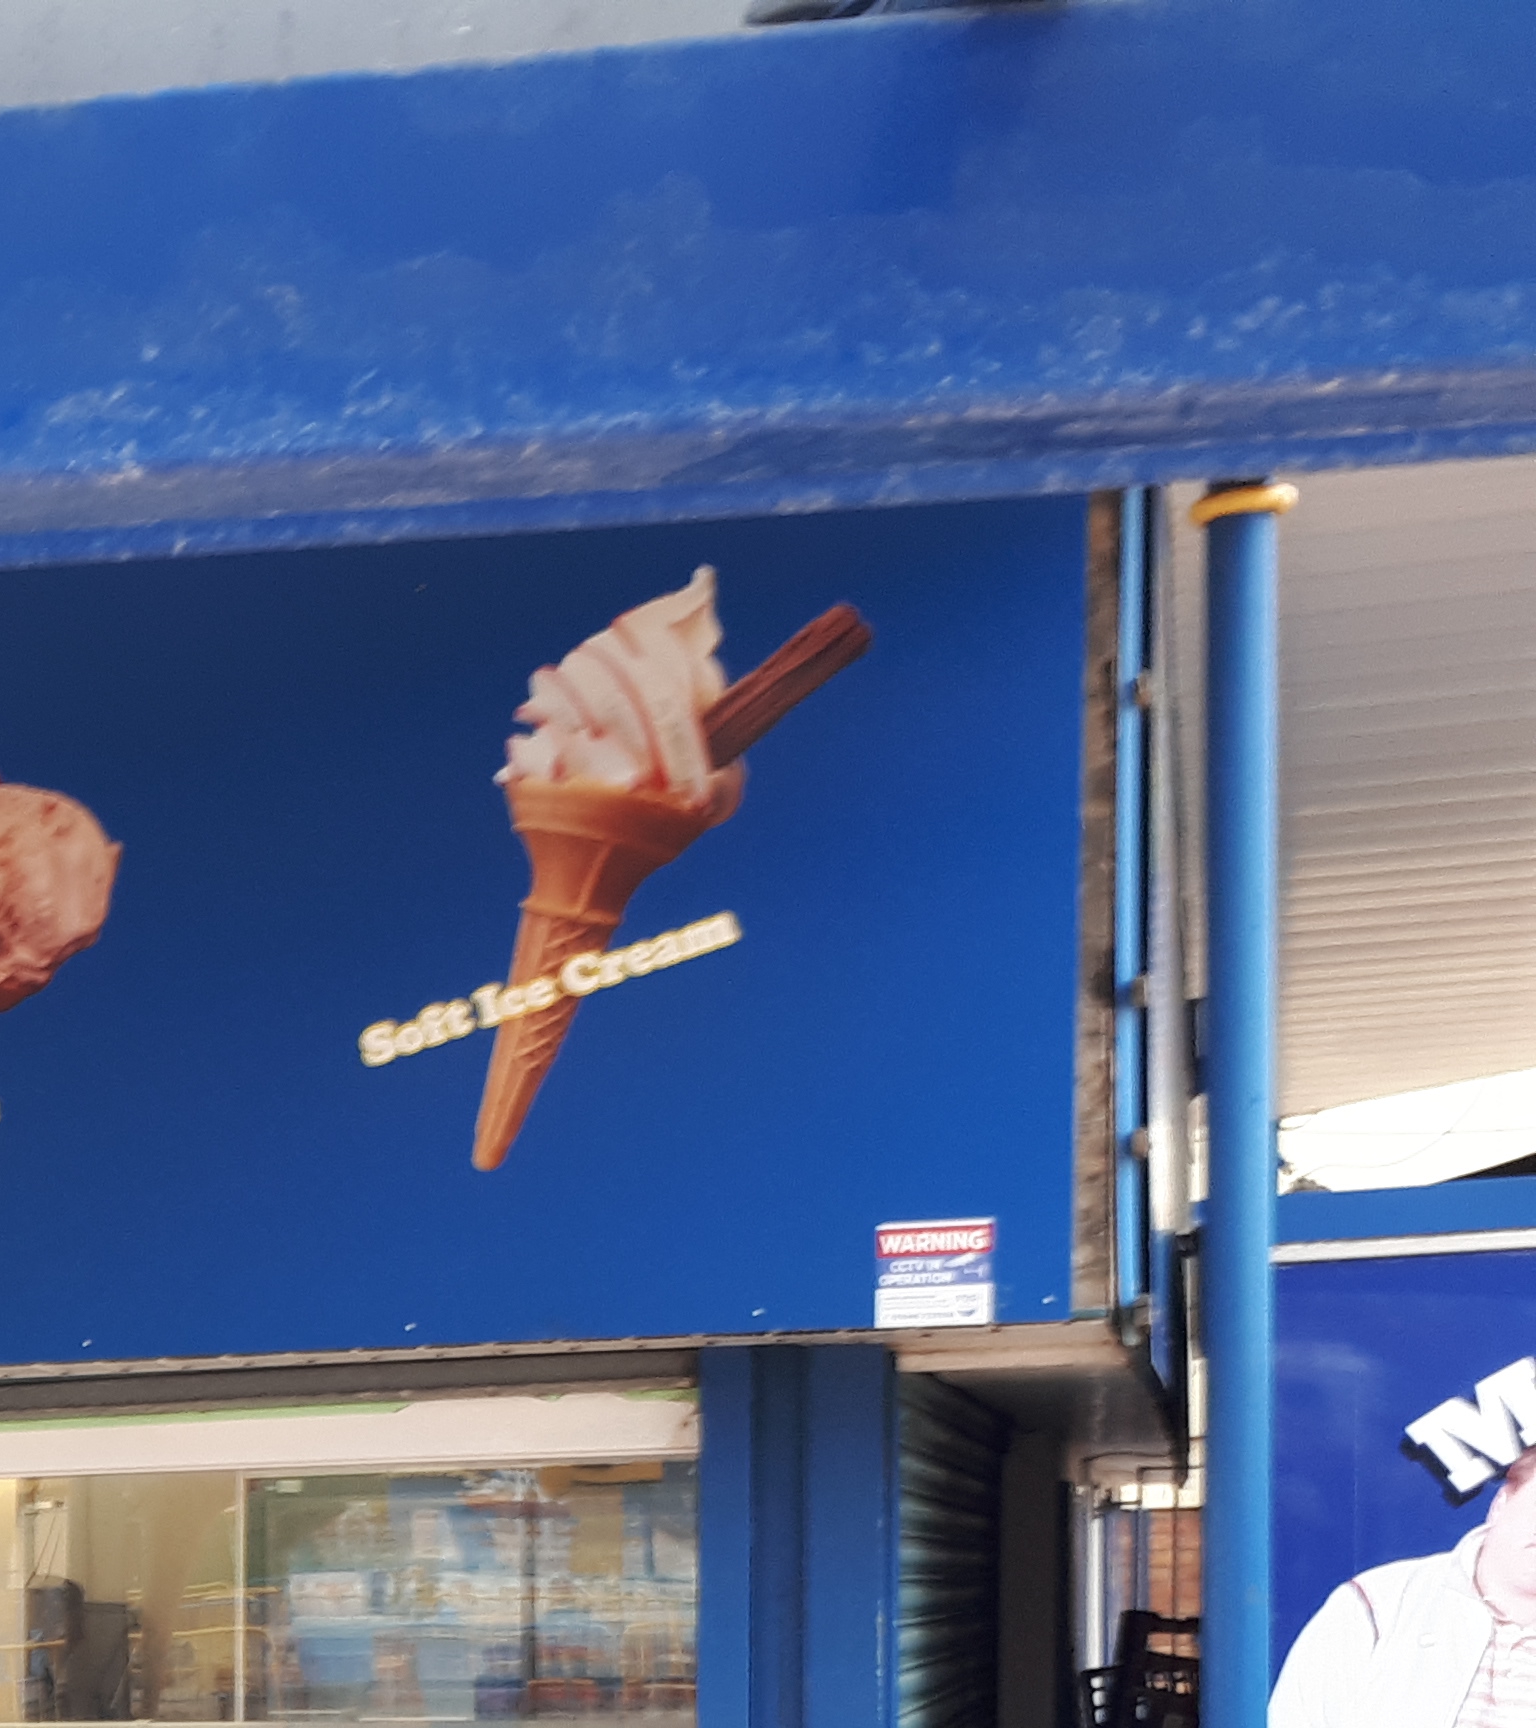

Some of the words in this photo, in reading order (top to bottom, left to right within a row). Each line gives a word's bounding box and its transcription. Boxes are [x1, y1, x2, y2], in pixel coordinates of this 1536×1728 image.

[358, 998, 476, 1068] Soft
[471, 974, 561, 1029] Ice
[561, 909, 743, 996] Cream
[879, 1228, 990, 1255] WARNING
